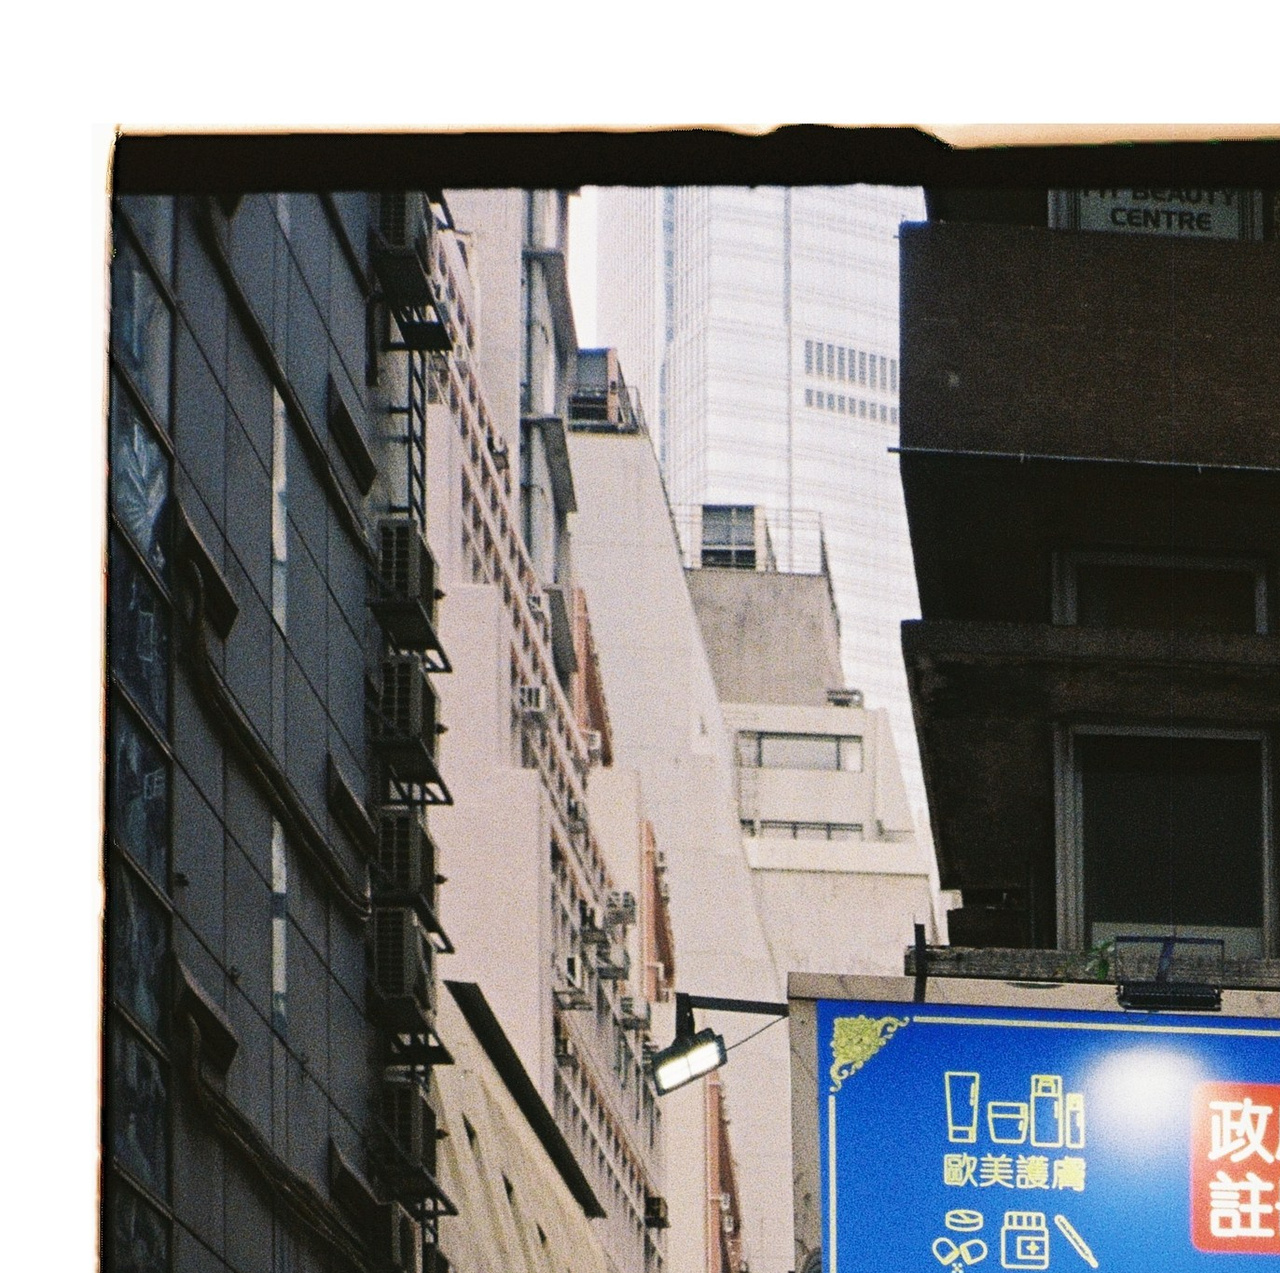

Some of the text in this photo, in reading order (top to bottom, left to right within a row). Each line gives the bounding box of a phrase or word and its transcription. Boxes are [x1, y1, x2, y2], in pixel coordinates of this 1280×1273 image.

[1110, 207, 1212, 231] CENTRE
[944, 1154, 1087, 1192] 歐美護膚
